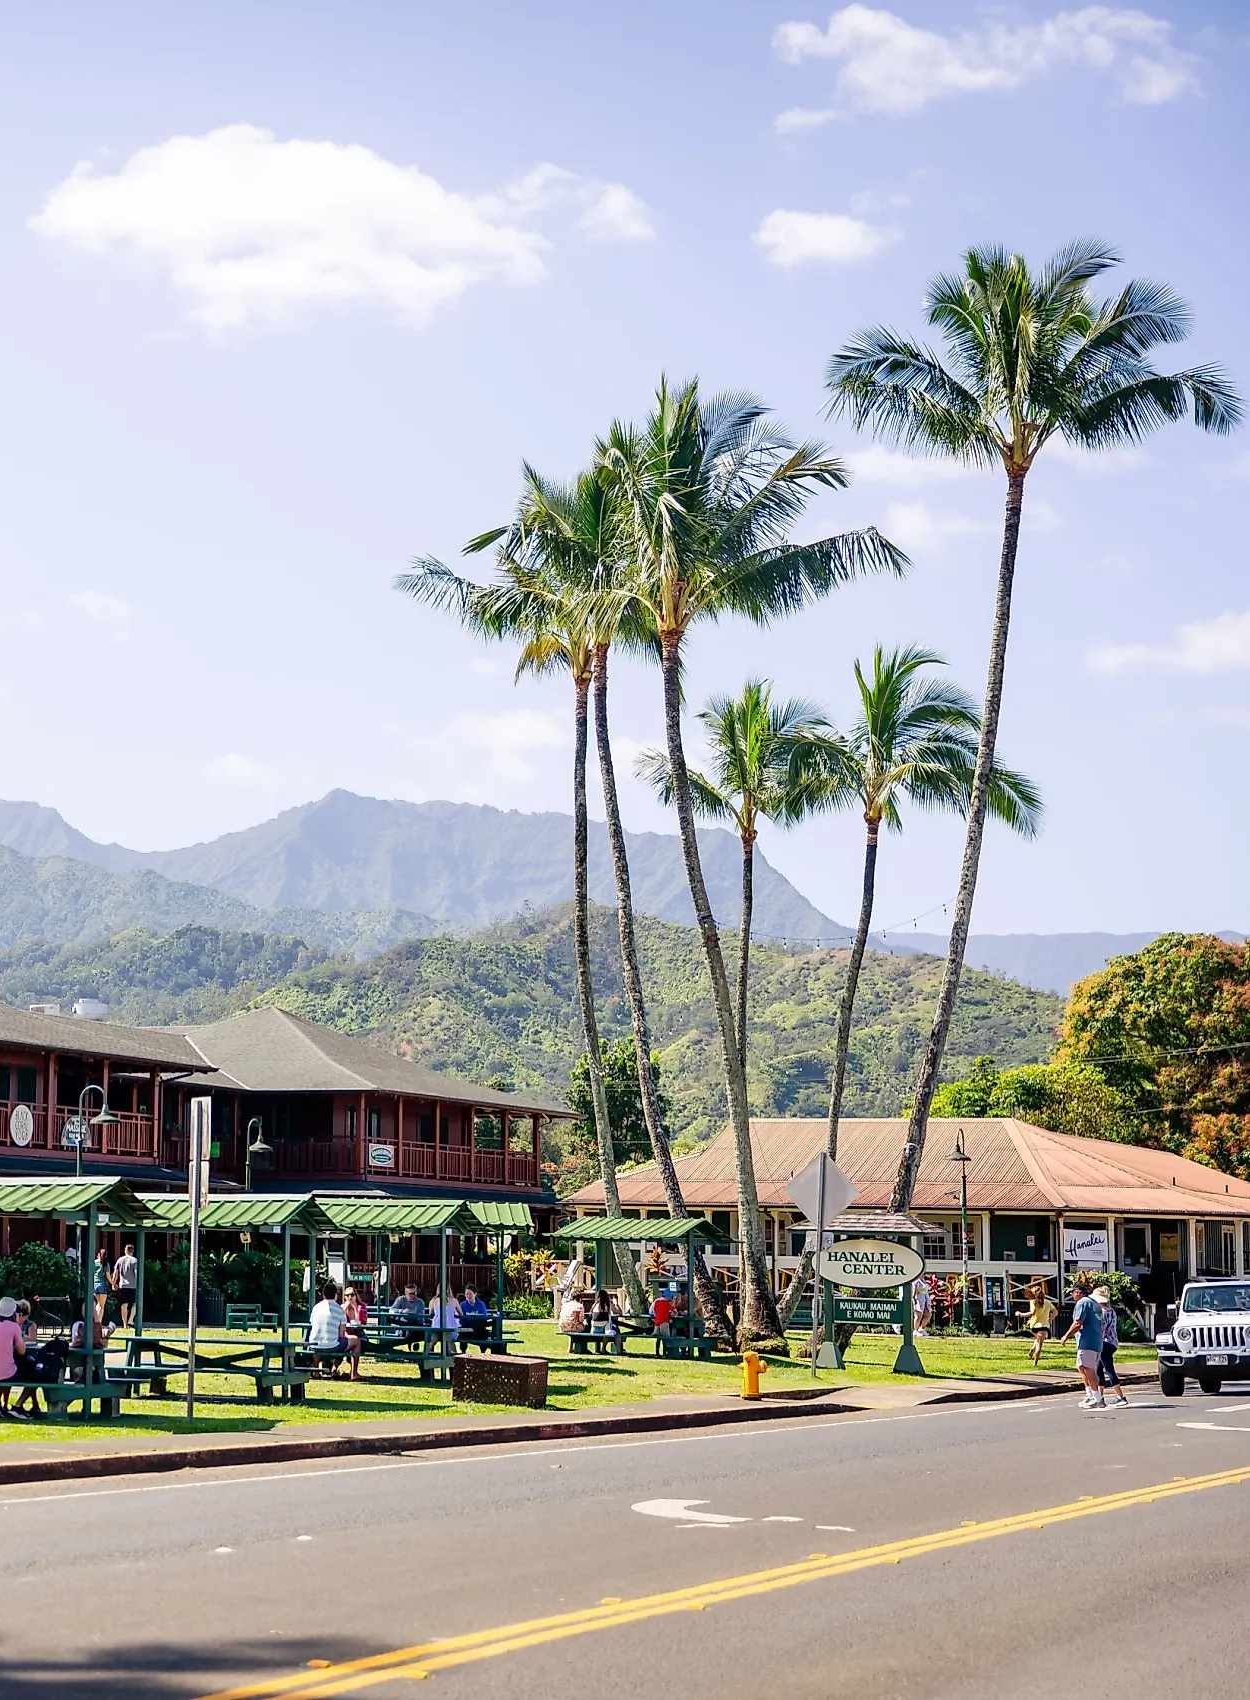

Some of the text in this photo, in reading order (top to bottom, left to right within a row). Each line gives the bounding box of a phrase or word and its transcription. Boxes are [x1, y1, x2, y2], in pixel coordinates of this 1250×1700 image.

[66, 1124, 87, 1133] MASSGE
[1065, 1233, 1105, 1257] Hanalei
[827, 1251, 894, 1263] HANALEI
[842, 1263, 907, 1275] CENTER
[839, 1301, 897, 1311] KAUKAU MAIMAI
[854, 1311, 874, 1319] KOMO
